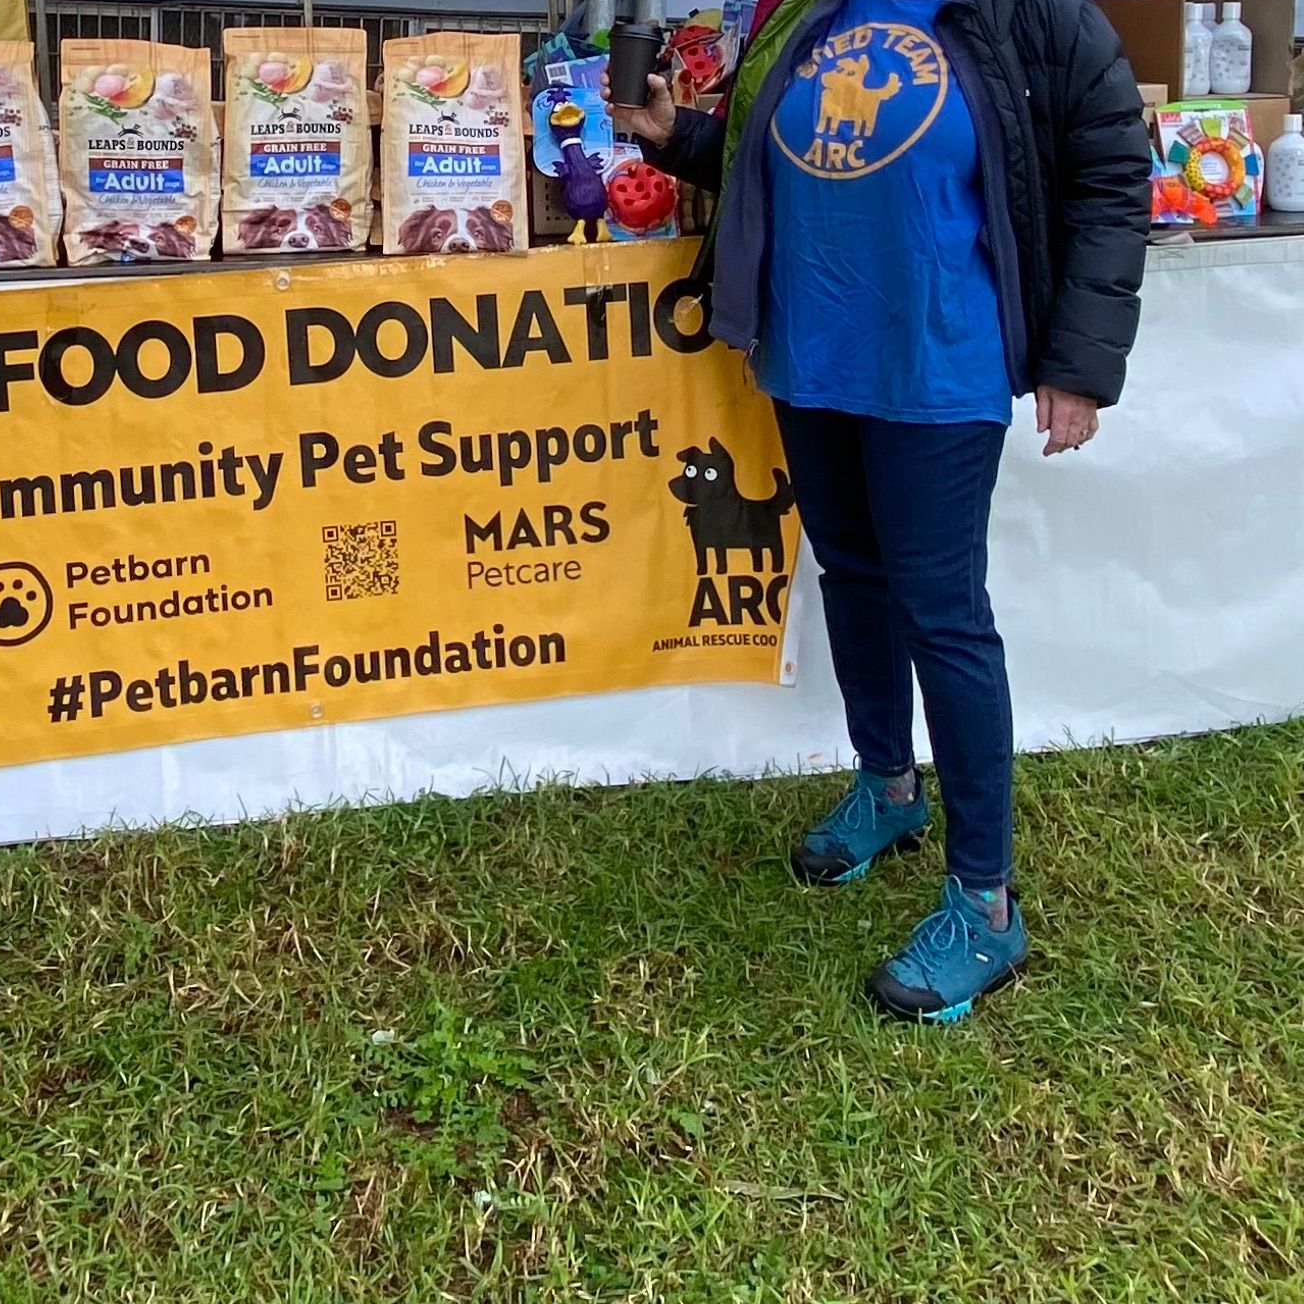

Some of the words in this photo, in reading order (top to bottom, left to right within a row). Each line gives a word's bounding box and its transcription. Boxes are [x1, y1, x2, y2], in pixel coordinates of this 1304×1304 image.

[883, 29, 940, 85] TEAM
[251, 124, 285, 135] LEAPS
[296, 123, 341, 134] BOUNDS
[409, 124, 443, 136] LEAPS
[455, 128, 499, 138] BOUNDS
[88, 139, 126, 150] LEAPS
[137, 140, 184, 150] BOUNDS
[264, 144, 297, 153] GRAIN
[300, 143, 327, 152] FREE
[422, 144, 457, 154] GRAIN
[459, 146, 486, 154] FREE
[802, 139, 866, 169] ARC
[103, 160, 138, 169] GRAIN
[141, 160, 169, 169] FREE
[264, 155, 322, 174] Adult
[422, 156, 482, 174] Adult
[104, 173, 165, 190] Adult
[284, 276, 744, 386] DONATIO
[299, 430, 405, 488] Pet
[417, 409, 660, 487] Support
[463, 501, 611, 554] MARS
[66, 553, 211, 589] Petbarn
[467, 557, 582, 590] Petcare
[68, 584, 273, 630] Foundation
[688, 575, 789, 628] ARC
[652, 636, 700, 653] ANIMAL
[702, 633, 750, 647] RESCUE
[47, 624, 566, 724] #PetbarnFoundation
